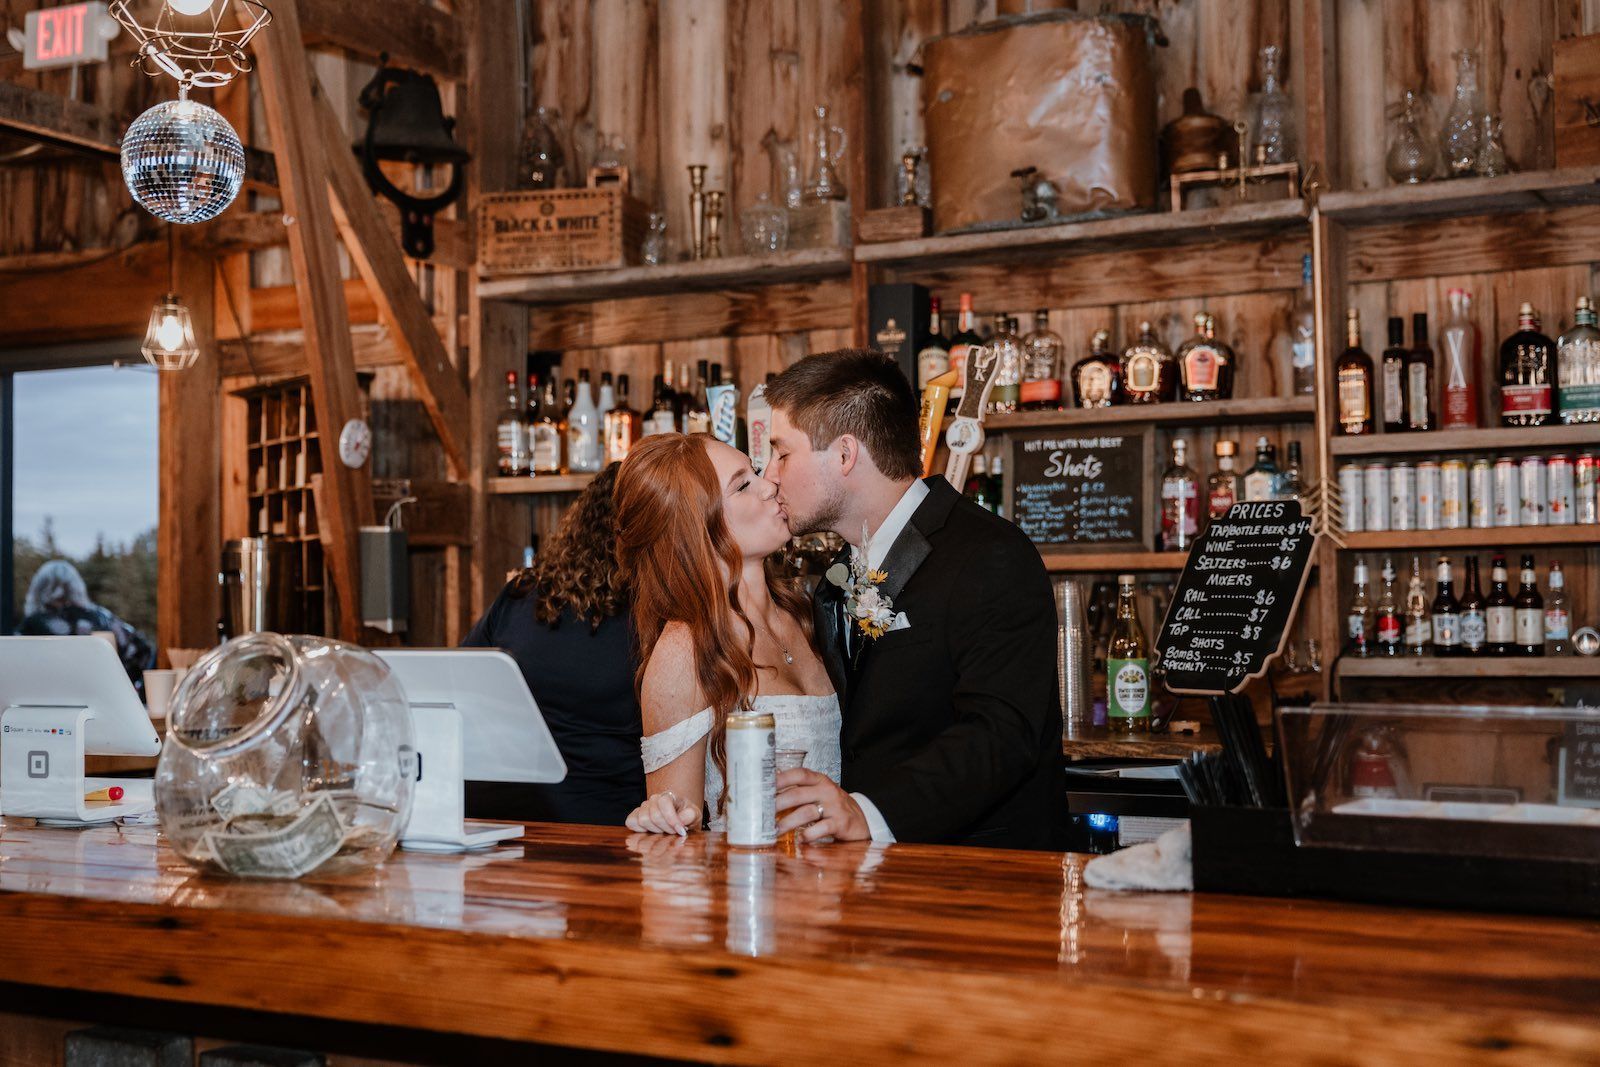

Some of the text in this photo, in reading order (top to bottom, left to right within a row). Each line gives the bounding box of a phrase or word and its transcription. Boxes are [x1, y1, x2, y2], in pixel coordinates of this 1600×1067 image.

[36, 3, 88, 60] EXIT
[544, 218, 553, 231] &
[1024, 439, 1042, 452] HIT
[1057, 438, 1078, 450] WITH
[1078, 437, 1099, 449] YOUR
[1099, 436, 1123, 448] BEST
[1043, 450, 1104, 479] Shots
[1229, 503, 1285, 519] PRICES
[1261, 525, 1284, 535] BEER
[1205, 537, 1300, 552] WINE $5
[1194, 555, 1292, 570] SELTZERS $6
[1206, 574, 1253, 586] MIXERS
[1184, 588, 1275, 605] RAIL $6
[1175, 606, 1269, 622] CALL $7
[1169, 623, 1262, 640] TOP $8
[1190, 637, 1224, 650] SHOTS
[1165, 646, 1253, 665] BOMBS $5
[1163, 660, 1207, 672] SPECIALTY
